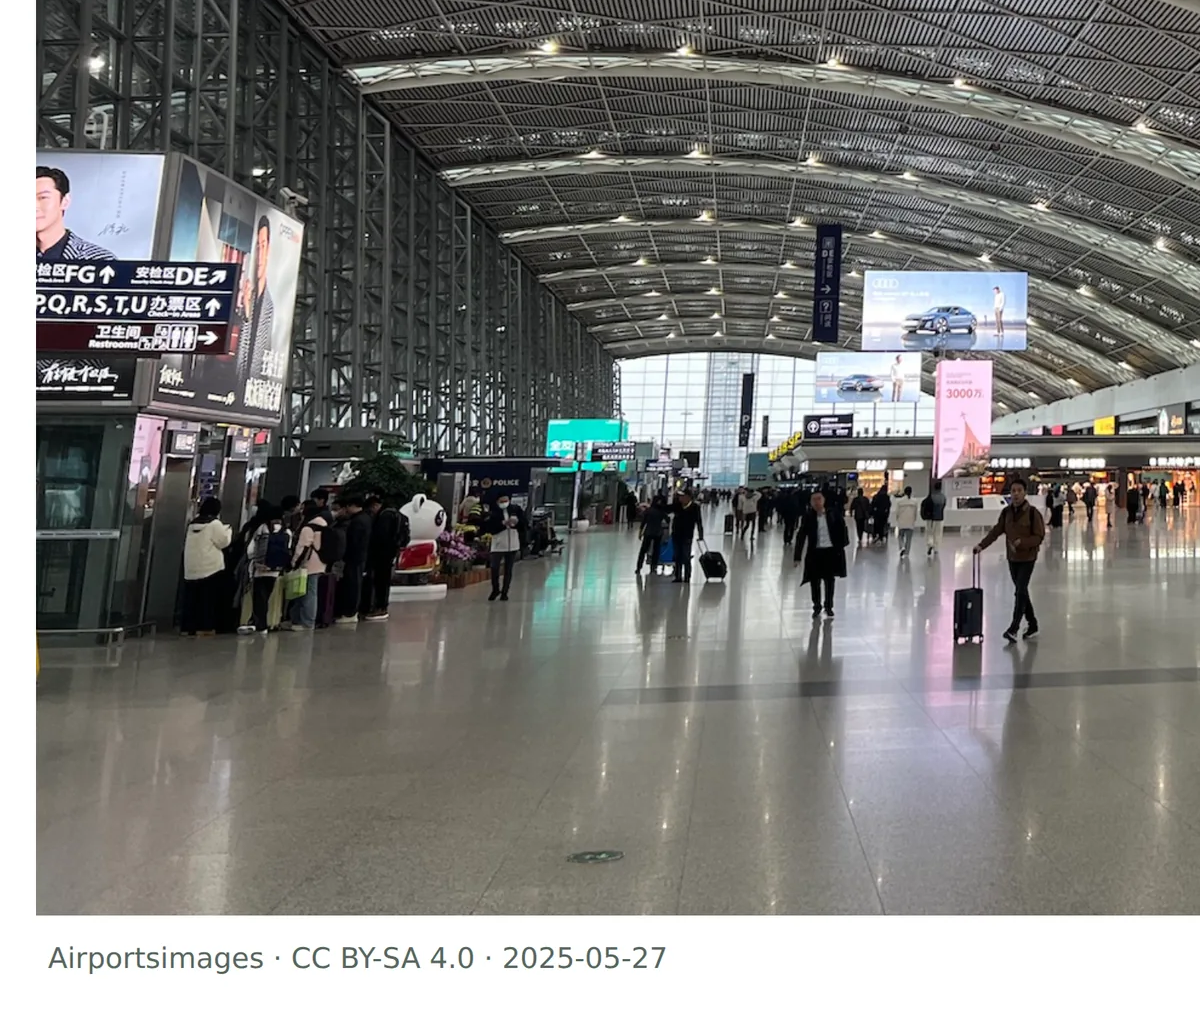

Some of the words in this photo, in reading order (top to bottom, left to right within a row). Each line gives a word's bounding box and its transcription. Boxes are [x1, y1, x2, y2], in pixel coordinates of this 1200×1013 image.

[36, 264, 66, 277] 检区
[64, 266, 96, 284] FG
[135, 266, 176, 279] 安检区
[174, 267, 209, 286] DE
[150, 295, 203, 312] 办票区
[95, 325, 141, 340] 卫生间
[88, 339, 139, 349] Restrooms
